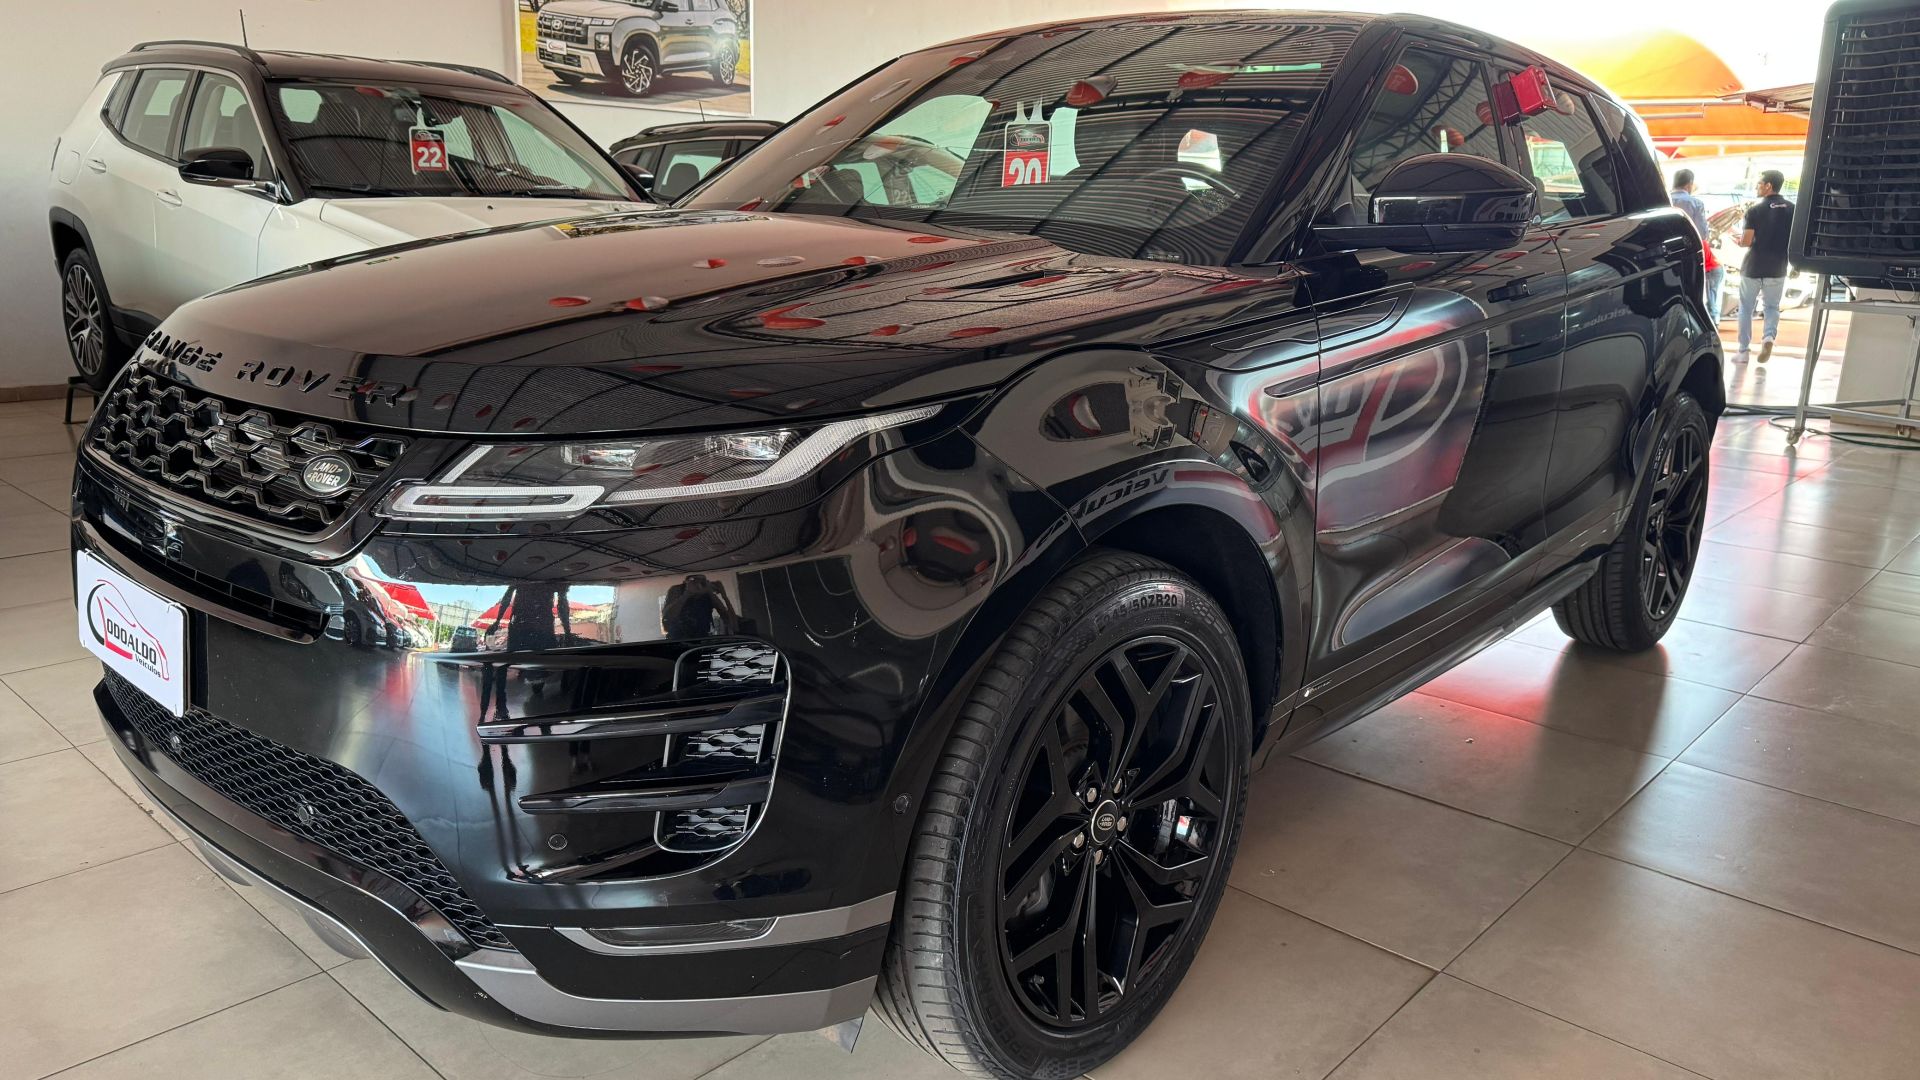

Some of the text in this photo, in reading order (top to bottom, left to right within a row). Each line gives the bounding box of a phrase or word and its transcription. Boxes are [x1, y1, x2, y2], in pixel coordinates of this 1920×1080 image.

[417, 147, 443, 168] 22
[1009, 157, 1042, 185] 20
[146, 330, 408, 408] RANGE ROVER
[313, 462, 340, 474] LAND
[309, 472, 341, 487] ROVER
